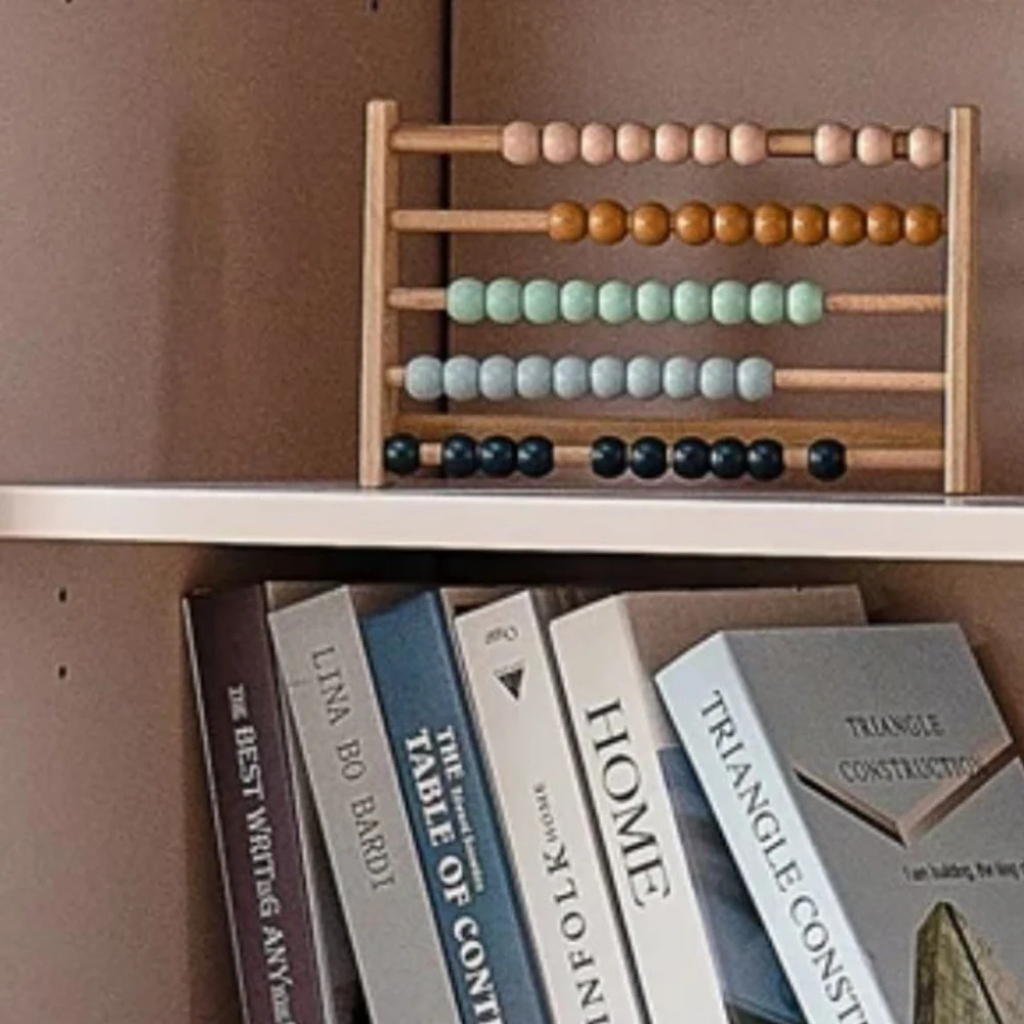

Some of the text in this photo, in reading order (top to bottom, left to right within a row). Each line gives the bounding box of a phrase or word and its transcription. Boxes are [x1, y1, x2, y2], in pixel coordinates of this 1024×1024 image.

[235, 725, 266, 801] BEST
[312, 646, 396, 891] LINA BO BARDI
[436, 725, 465, 780] THE
[585, 697, 671, 908] HOME
[701, 689, 804, 893] TRIANGLE
[845, 713, 945, 738] TRIANGLE
[405, 727, 456, 847] TABLE
[437, 855, 471, 907] OF
